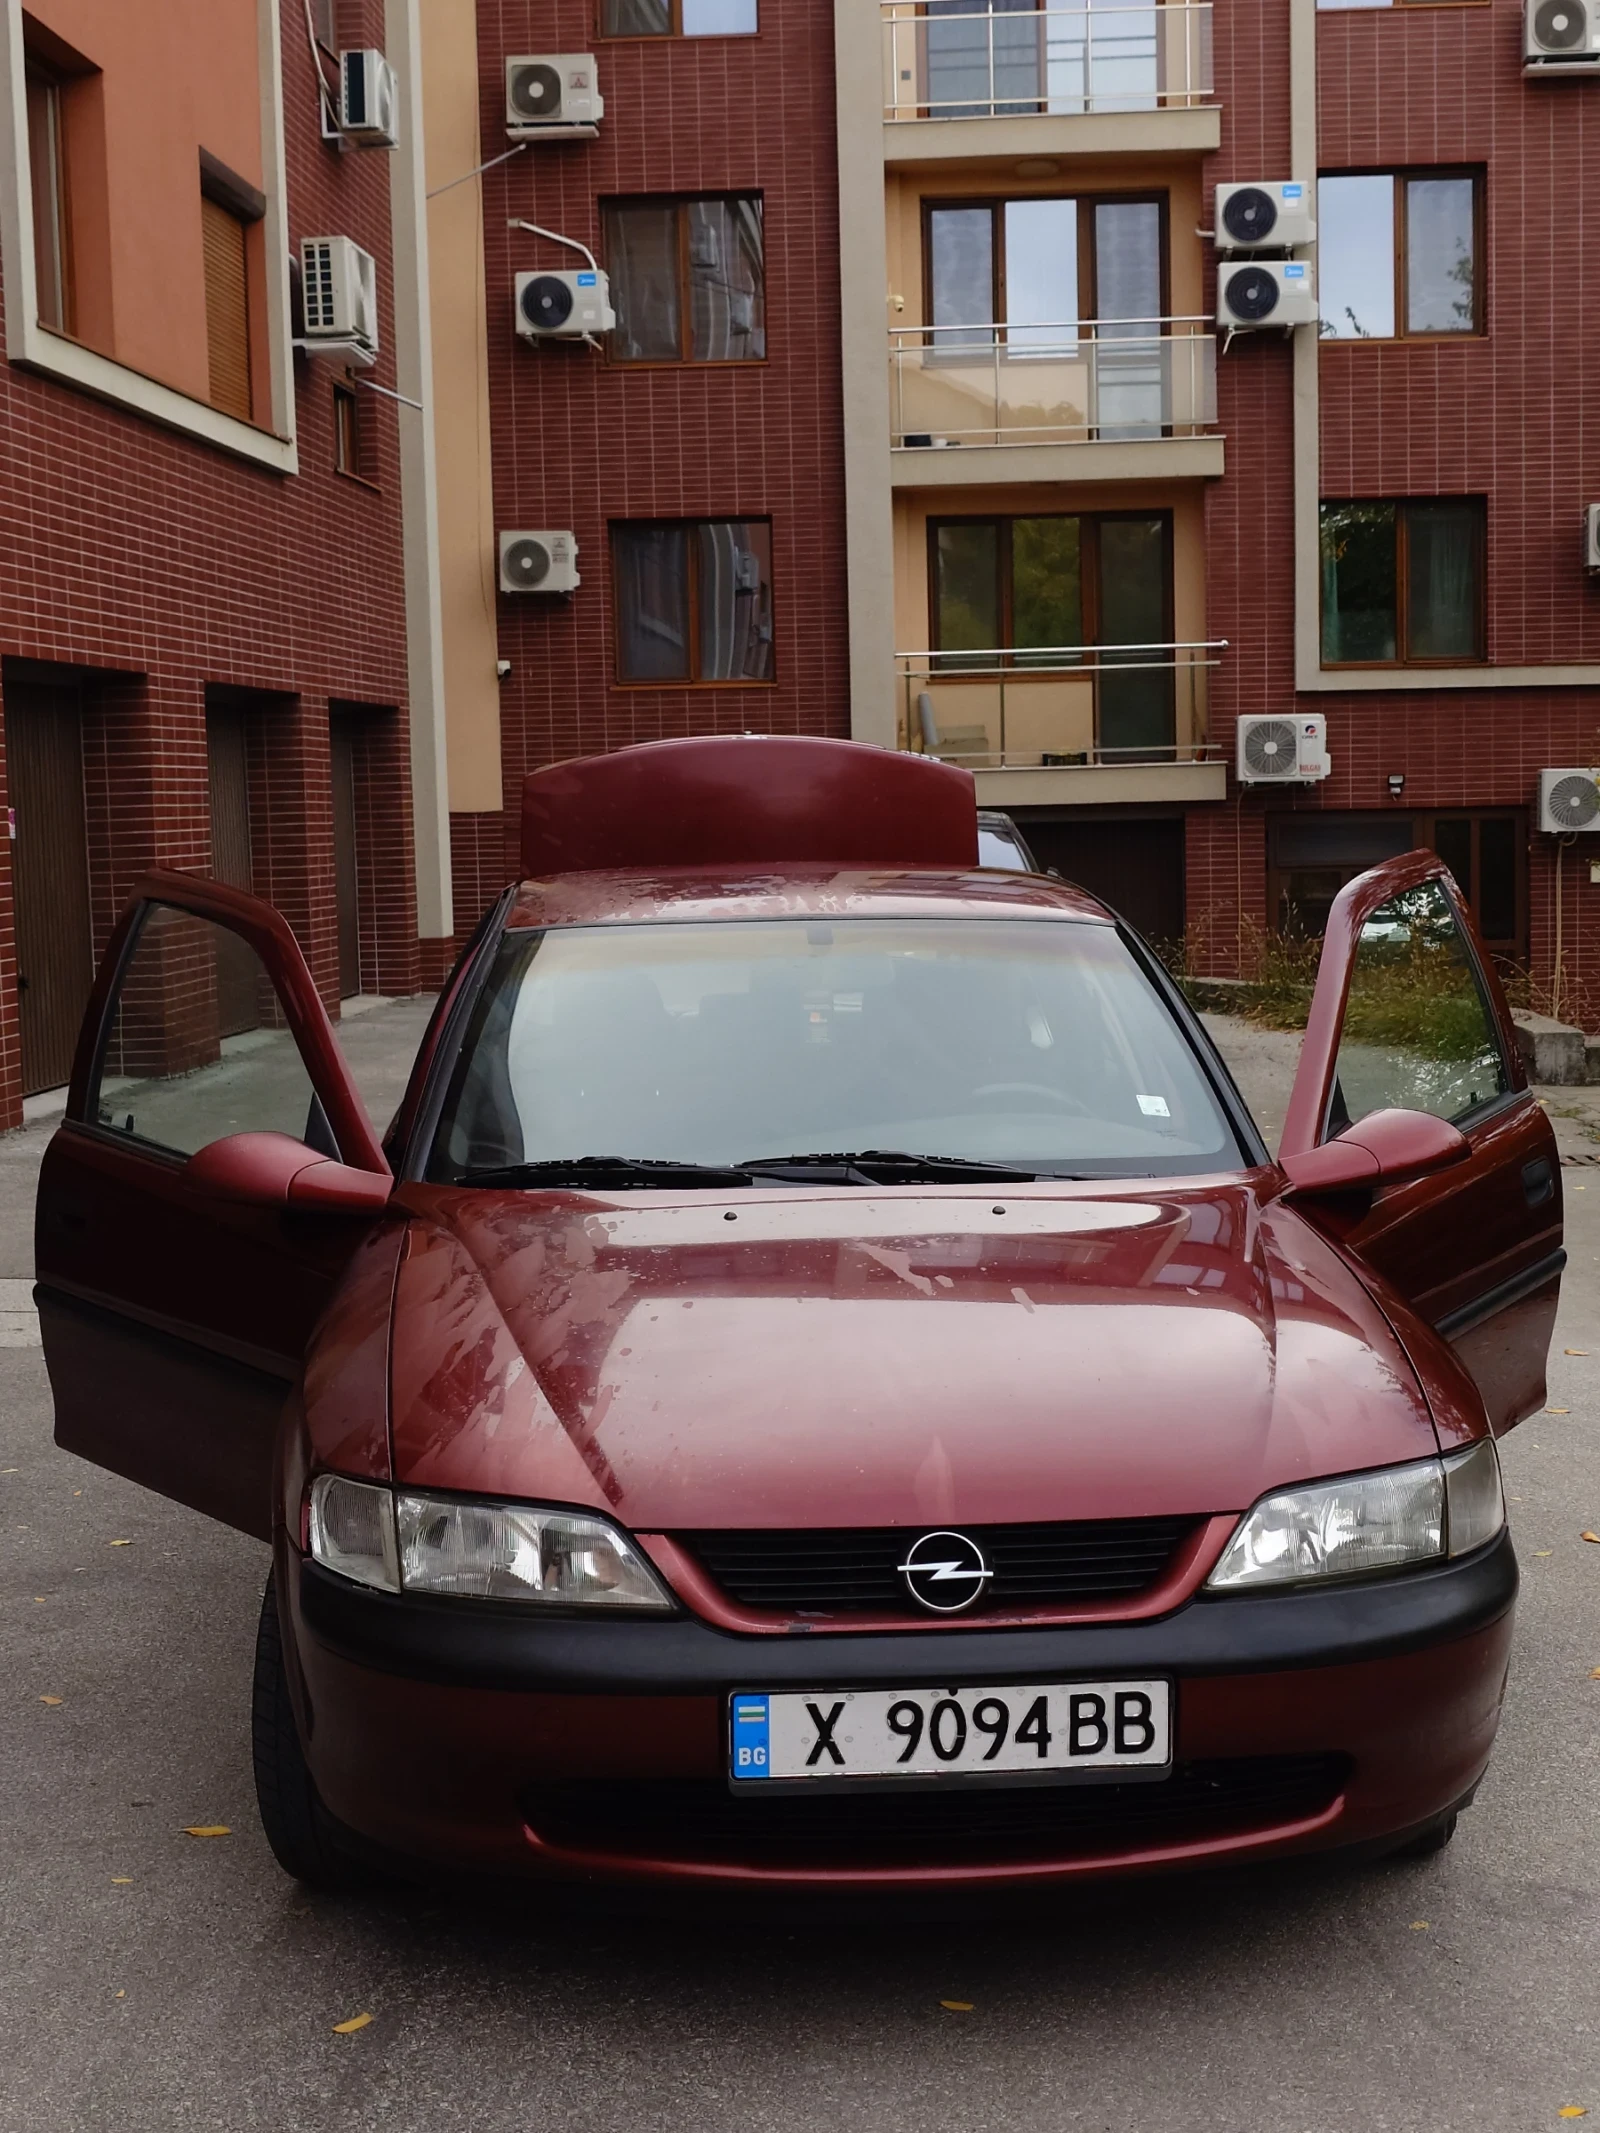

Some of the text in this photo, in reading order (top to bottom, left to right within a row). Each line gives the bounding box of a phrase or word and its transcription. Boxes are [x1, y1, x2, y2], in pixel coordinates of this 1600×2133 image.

[805, 1691, 1156, 1766] X 9094 BB
[738, 1747, 766, 1766] BG
